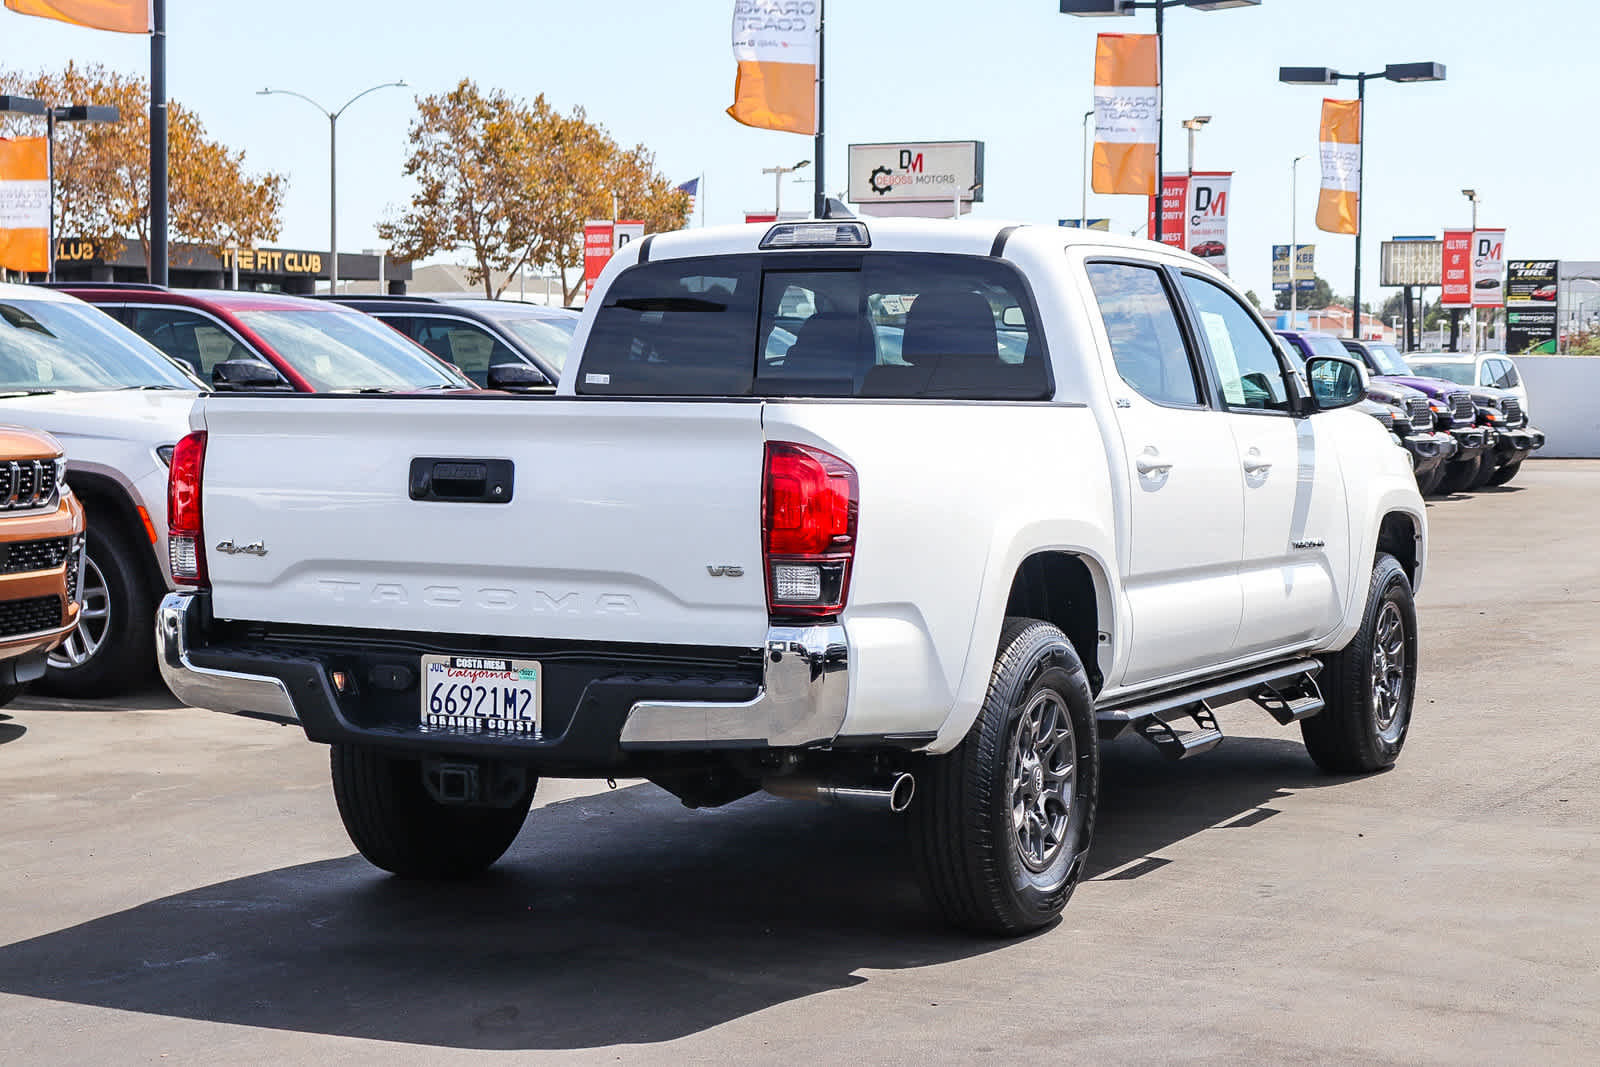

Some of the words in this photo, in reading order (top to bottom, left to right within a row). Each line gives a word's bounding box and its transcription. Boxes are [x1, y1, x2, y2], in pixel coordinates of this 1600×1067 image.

[899, 149, 923, 173] DM
[916, 174, 955, 185] MOTORS
[1162, 187, 1184, 197] ALITY
[1162, 200, 1180, 208] OUR
[1195, 187, 1227, 216] DM
[56, 242, 94, 260] LUB
[258, 250, 282, 271] FIT
[285, 252, 322, 273] CLUB
[707, 565, 744, 577] V6
[316, 579, 641, 616] TACOMA
[456, 658, 483, 669] COSTA
[483, 660, 506, 671] MESA
[430, 682, 532, 721] 66921M2
[429, 715, 482, 728] ORANGE
[488, 719, 533, 732] COAST
